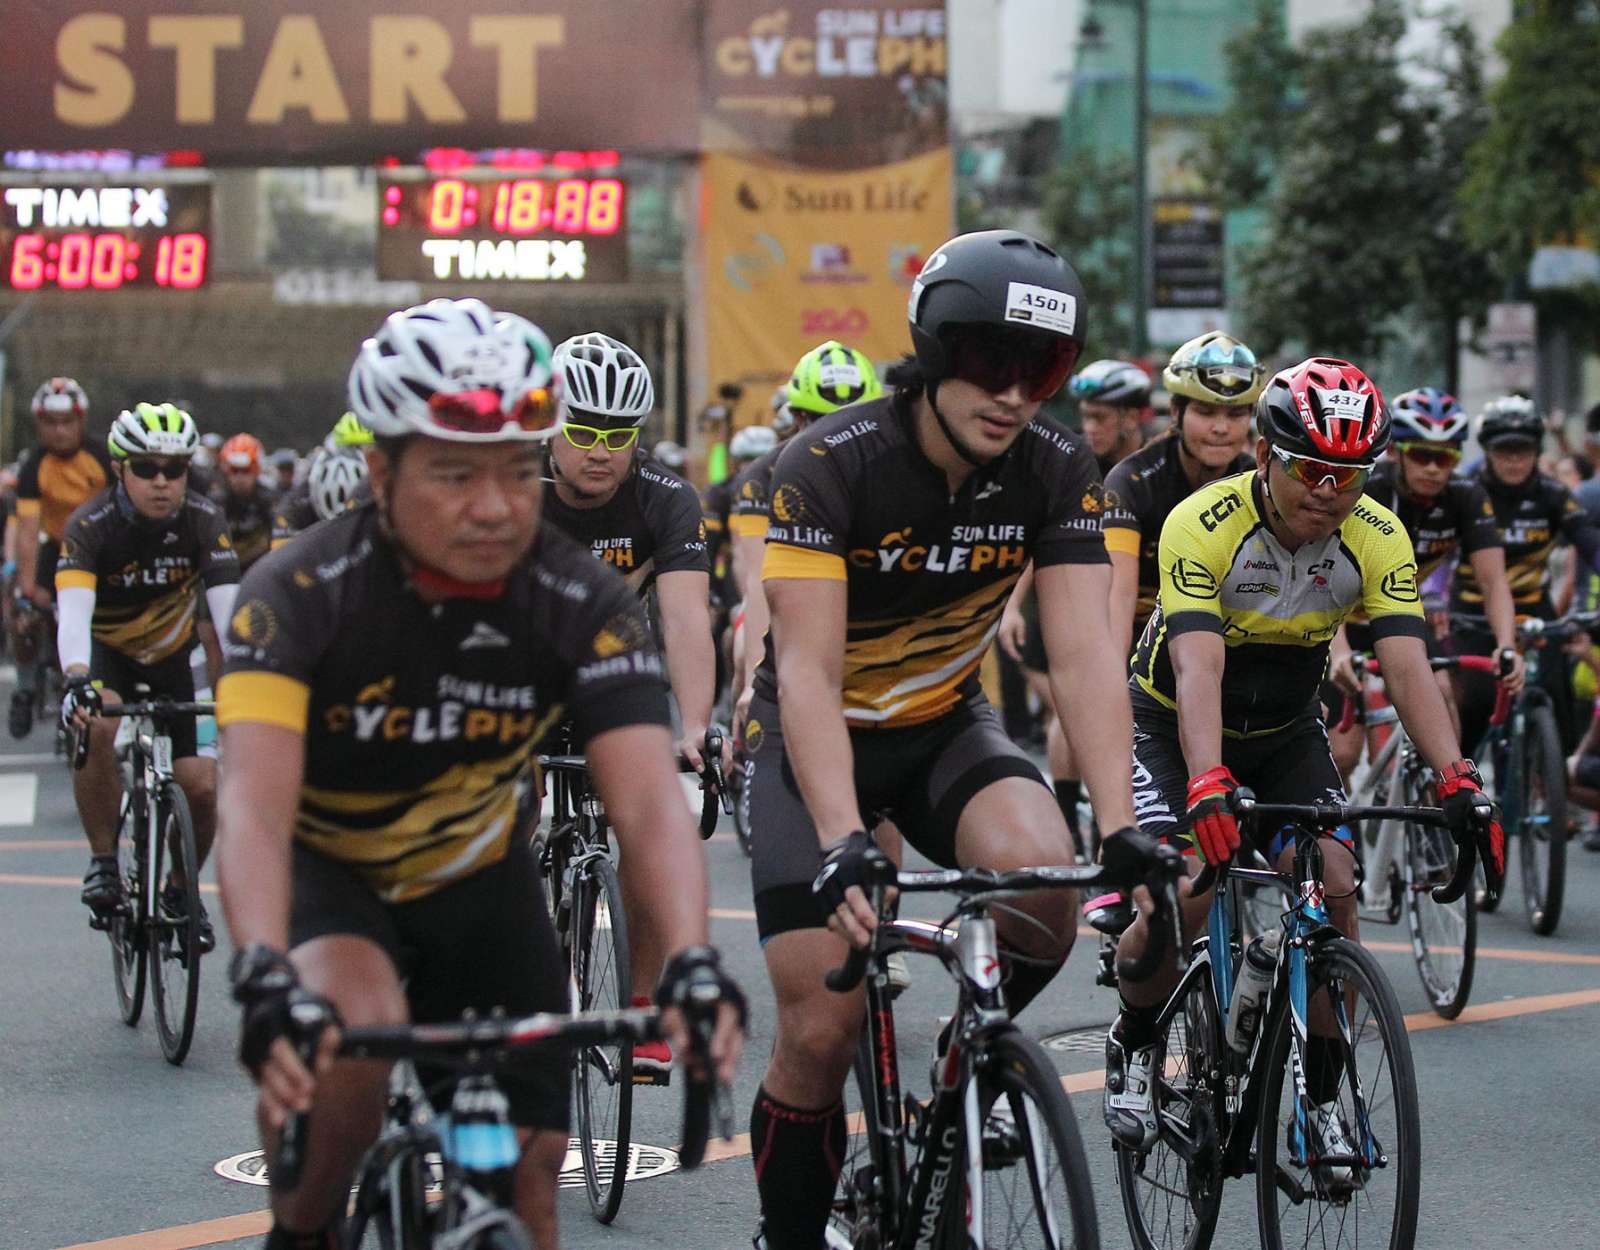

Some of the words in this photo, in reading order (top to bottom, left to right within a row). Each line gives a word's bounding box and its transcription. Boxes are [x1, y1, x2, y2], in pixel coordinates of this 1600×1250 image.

[816, 9, 879, 35] SUN
[54, 14, 566, 127] START
[716, 35, 947, 79] CYCLEPH
[5, 188, 168, 227] TIMEX
[784, 184, 853, 212] Sun
[862, 181, 930, 211] Life
[422, 239, 587, 279] TIMEX
[1019, 293, 1067, 314] A501
[1297, 391, 1319, 433] MET
[1328, 395, 1361, 406] 437
[824, 430, 854, 448] Sun
[850, 420, 879, 436] Life
[1027, 420, 1052, 440] Sun
[1052, 432, 1076, 455] Life
[640, 467, 661, 482] Sun
[767, 525, 788, 541] un
[793, 526, 834, 545] Life
[952, 525, 984, 542] SUN
[988, 525, 1025, 540] LIFE
[850, 545, 1025, 573] CYCLEPH
[437, 674, 483, 703] SUN
[484, 684, 536, 709] LIFE
[324, 702, 537, 743] CYCLEPH
